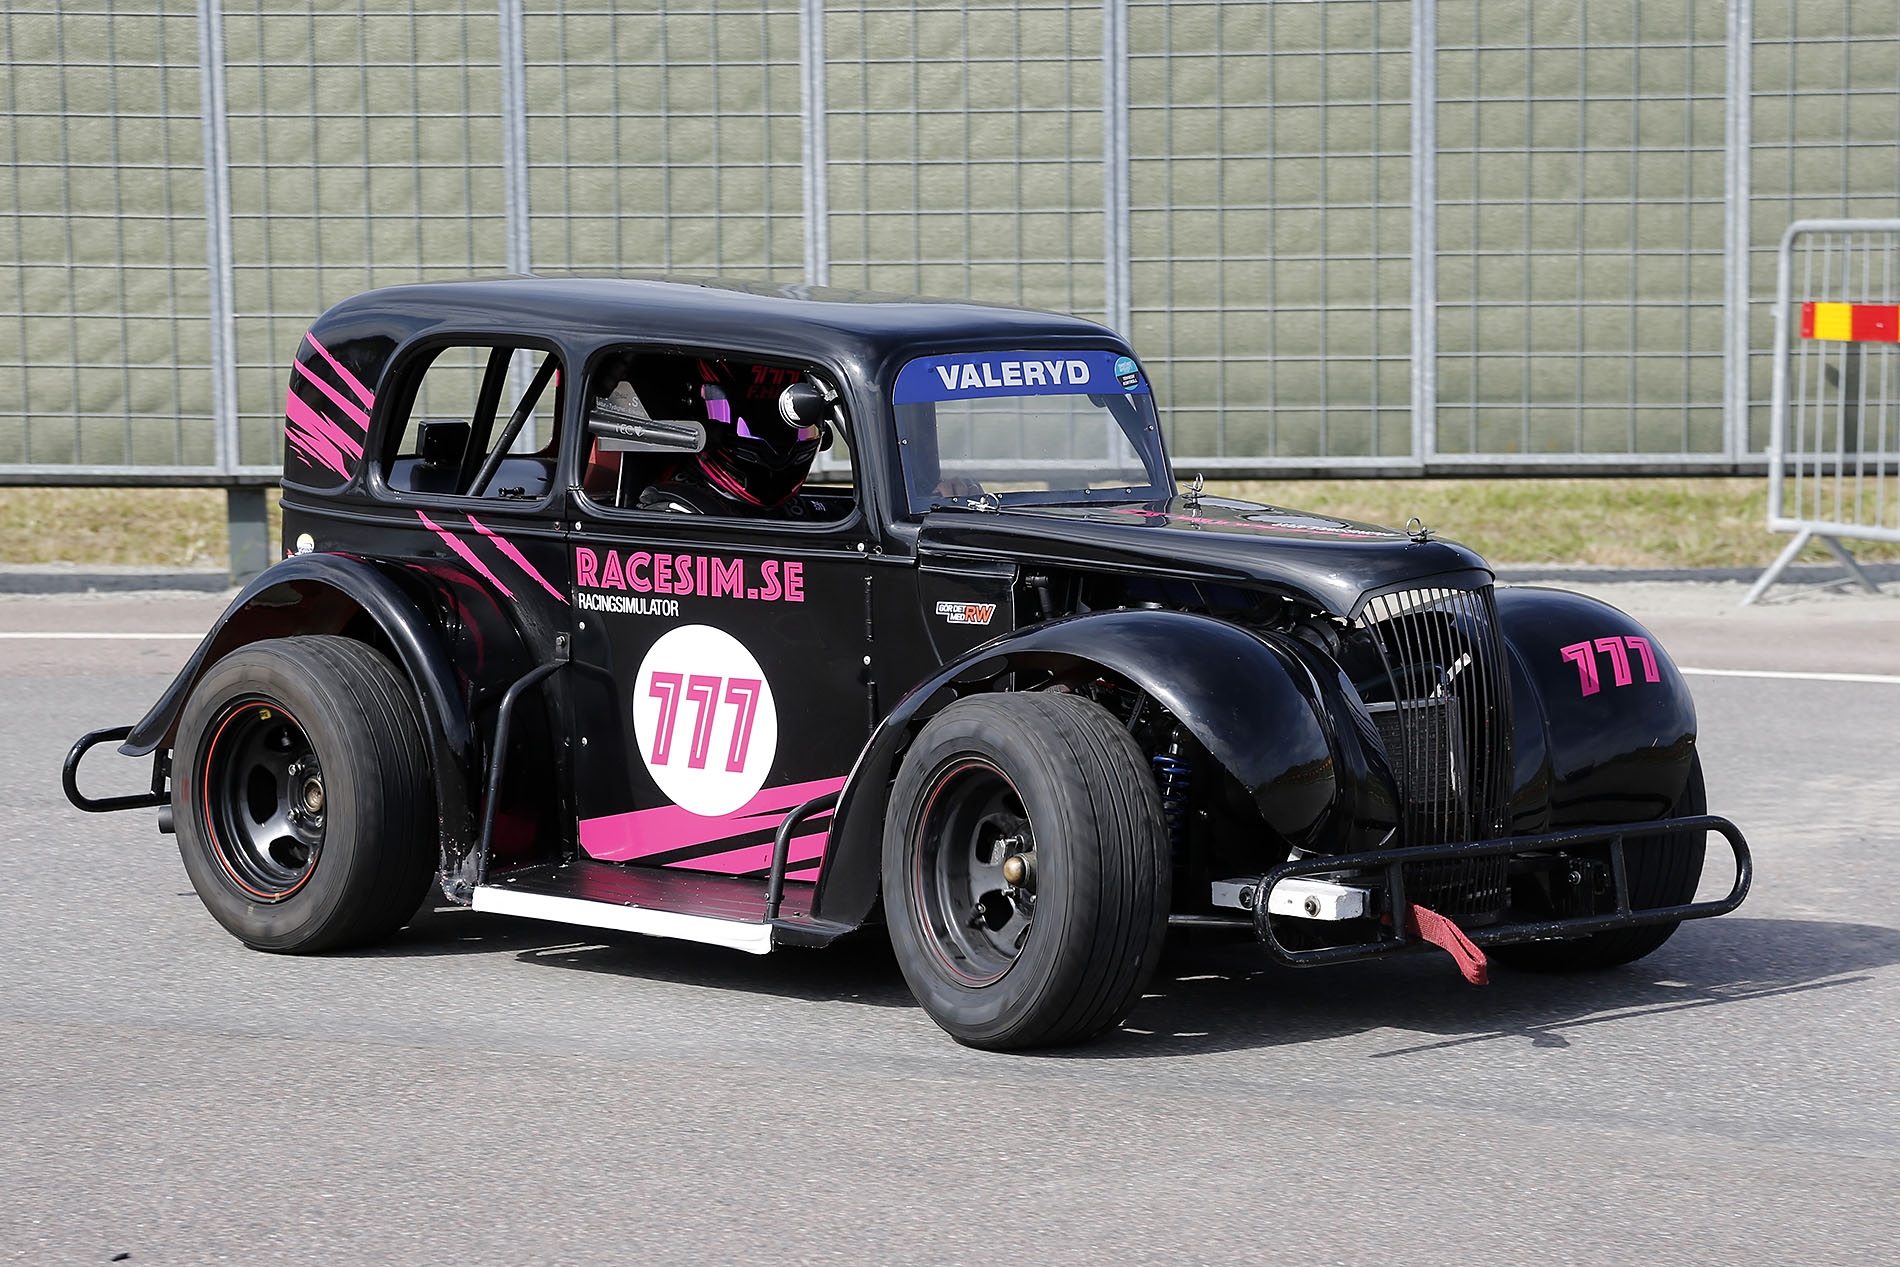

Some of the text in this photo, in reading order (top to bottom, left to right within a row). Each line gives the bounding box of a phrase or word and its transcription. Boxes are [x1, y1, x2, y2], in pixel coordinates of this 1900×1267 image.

[936, 360, 1091, 390] VALERYD
[575, 546, 805, 602] RACESIM.SE
[578, 593, 680, 617] RACINGSIMULATOR
[965, 605, 993, 623] RW
[1560, 636, 1661, 697] 777
[648, 671, 762, 773] 777
